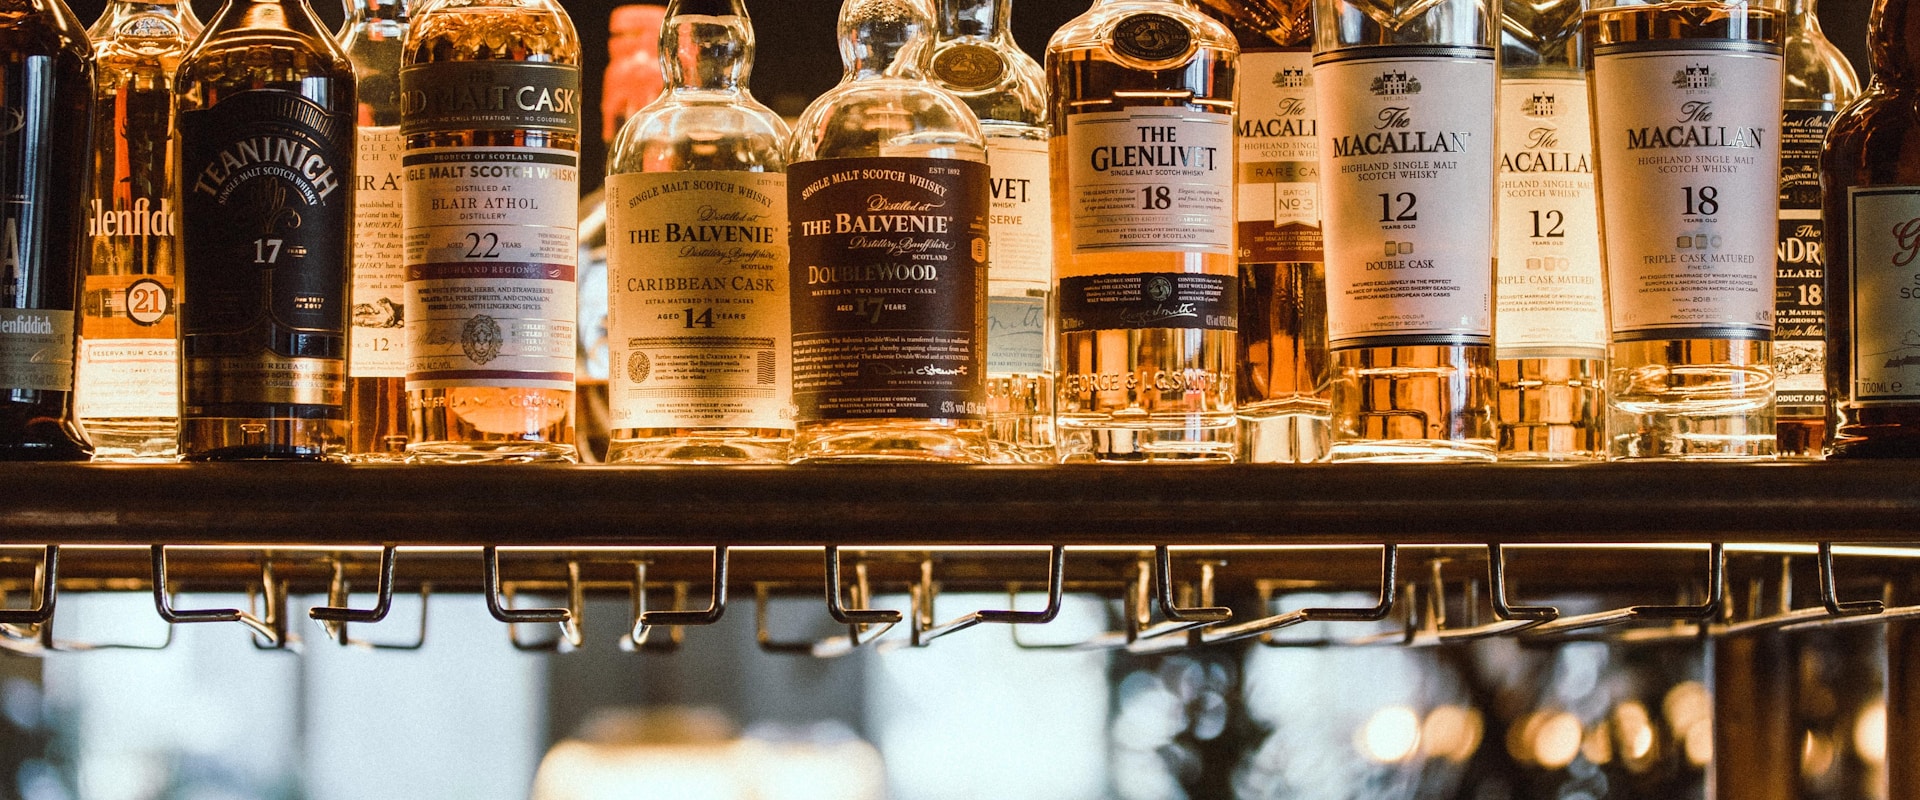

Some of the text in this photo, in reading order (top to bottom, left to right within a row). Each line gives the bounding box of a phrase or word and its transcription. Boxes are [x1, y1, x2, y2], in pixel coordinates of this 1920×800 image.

[516, 86, 575, 115] CASK
[1276, 98, 1304, 116] The
[1374, 107, 1409, 130] The
[1677, 101, 1712, 123] The
[1137, 127, 1176, 143] THE
[1333, 132, 1468, 158] MACALLAN
[1524, 128, 1557, 149] The
[1627, 125, 1761, 149] MACALLAN
[194, 137, 339, 201] TEANINICH
[1091, 146, 1217, 172] GLENLIVET
[1341, 161, 1457, 173] HIGHLAND SINGLE MALT
[1638, 156, 1754, 165] HIGHLAND SINGLE MALT
[1703, 165, 1737, 173] WHISKY
[430, 167, 466, 179] MALT
[470, 166, 532, 178] SCOTCH
[537, 167, 577, 183] WHISKY
[948, 168, 960, 178] 1892
[1256, 169, 1293, 177] RARE
[1358, 171, 1438, 181] SCOTCH WHISKY
[219, 166, 318, 207] SINGLE MALT SCOTCH WHISKY
[629, 181, 773, 209] SINGLE MALT SCOTCH WHISKY
[802, 177, 830, 200] SINGLE
[832, 170, 860, 187] MALT
[863, 170, 905, 182] SCOTCH
[909, 173, 947, 198] WHISKY
[1507, 190, 1580, 198] SCOTCH WHISKY
[432, 198, 538, 211] BLAIR ATHOL
[867, 194, 945, 212] Distilled at
[1141, 186, 1172, 210] 18
[1378, 192, 1417, 222] 12
[1682, 186, 1719, 216] 18
[697, 205, 745, 222] Distilled
[990, 215, 1022, 225] SERVE
[1529, 210, 1565, 238] 12
[629, 223, 774, 244] THE BALVENIE
[803, 214, 948, 236] THE BALVENIE
[1795, 225, 1820, 237] The
[254, 239, 282, 263] 17
[465, 233, 500, 258] 22
[1366, 260, 1434, 271] DOUBLE CASK
[1643, 254, 1754, 264] TRIPLE CASK MATURED
[628, 277, 775, 292] CARIBBEAN CASK
[1530, 277, 1554, 285] CASK
[134, 289, 161, 313] 21
[1799, 284, 1822, 305] 18
[683, 308, 716, 329] 14
[857, 298, 885, 323] 17
[372, 339, 389, 352] 12
[865, 335, 900, 343] DoubleWood
[1065, 372, 1138, 393] GEORGE &
[1861, 383, 1888, 393] 700ML
[942, 402, 954, 413] 43%
